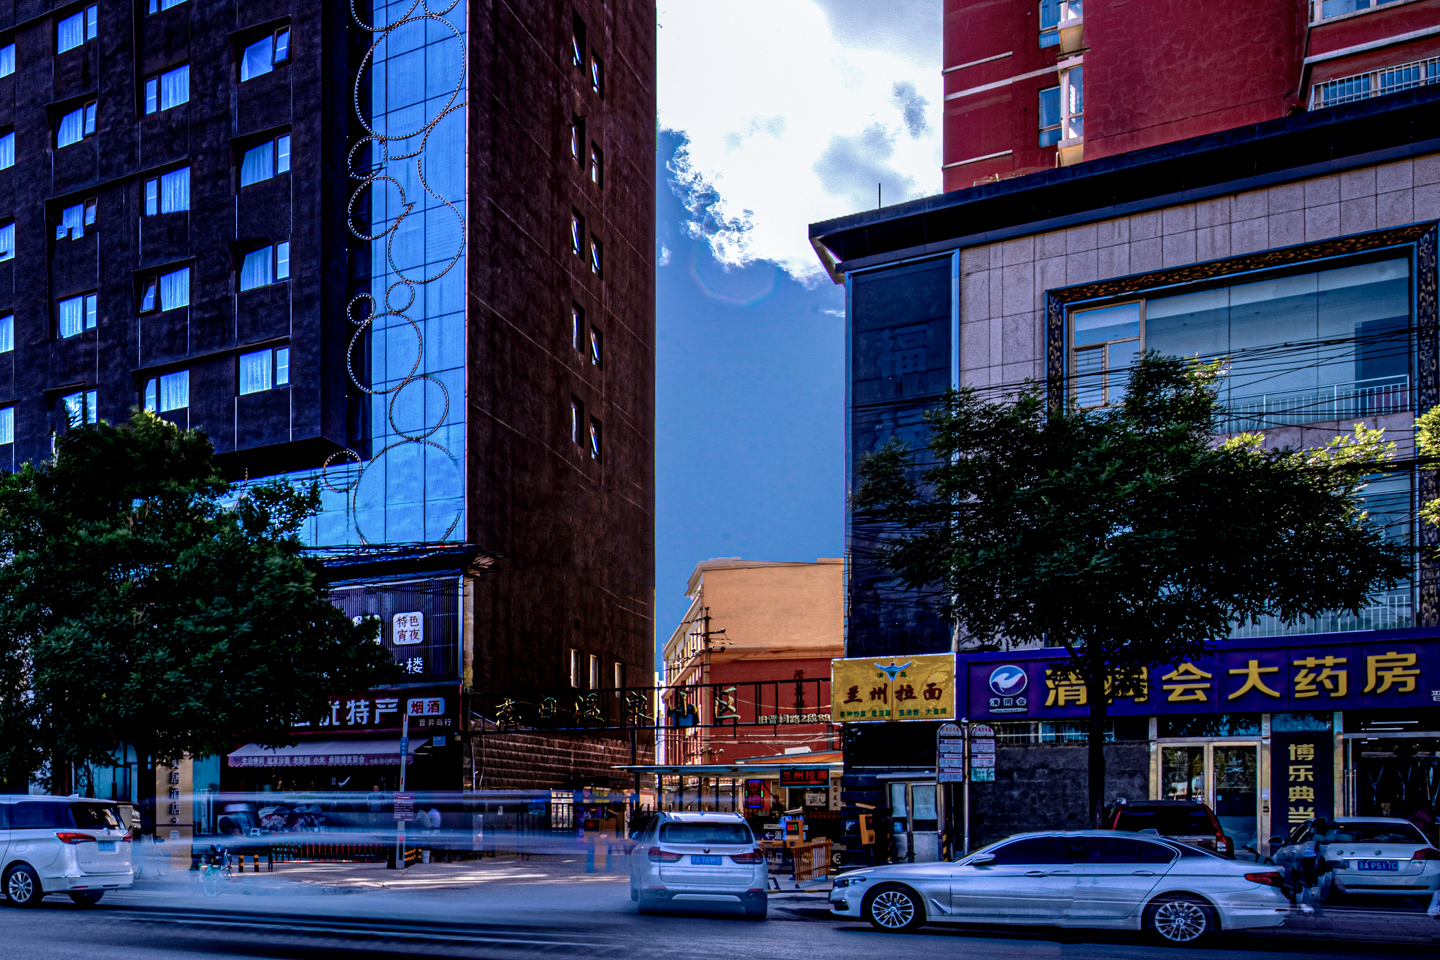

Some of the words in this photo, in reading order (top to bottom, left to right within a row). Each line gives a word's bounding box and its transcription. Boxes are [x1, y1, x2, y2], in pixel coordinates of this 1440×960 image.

[396, 615, 421, 628] 特色
[396, 629, 421, 642] 宵夜
[843, 682, 943, 705] 兰州拉面
[411, 700, 440, 714] 烟酒
[1287, 743, 1315, 834] 博乐典当
